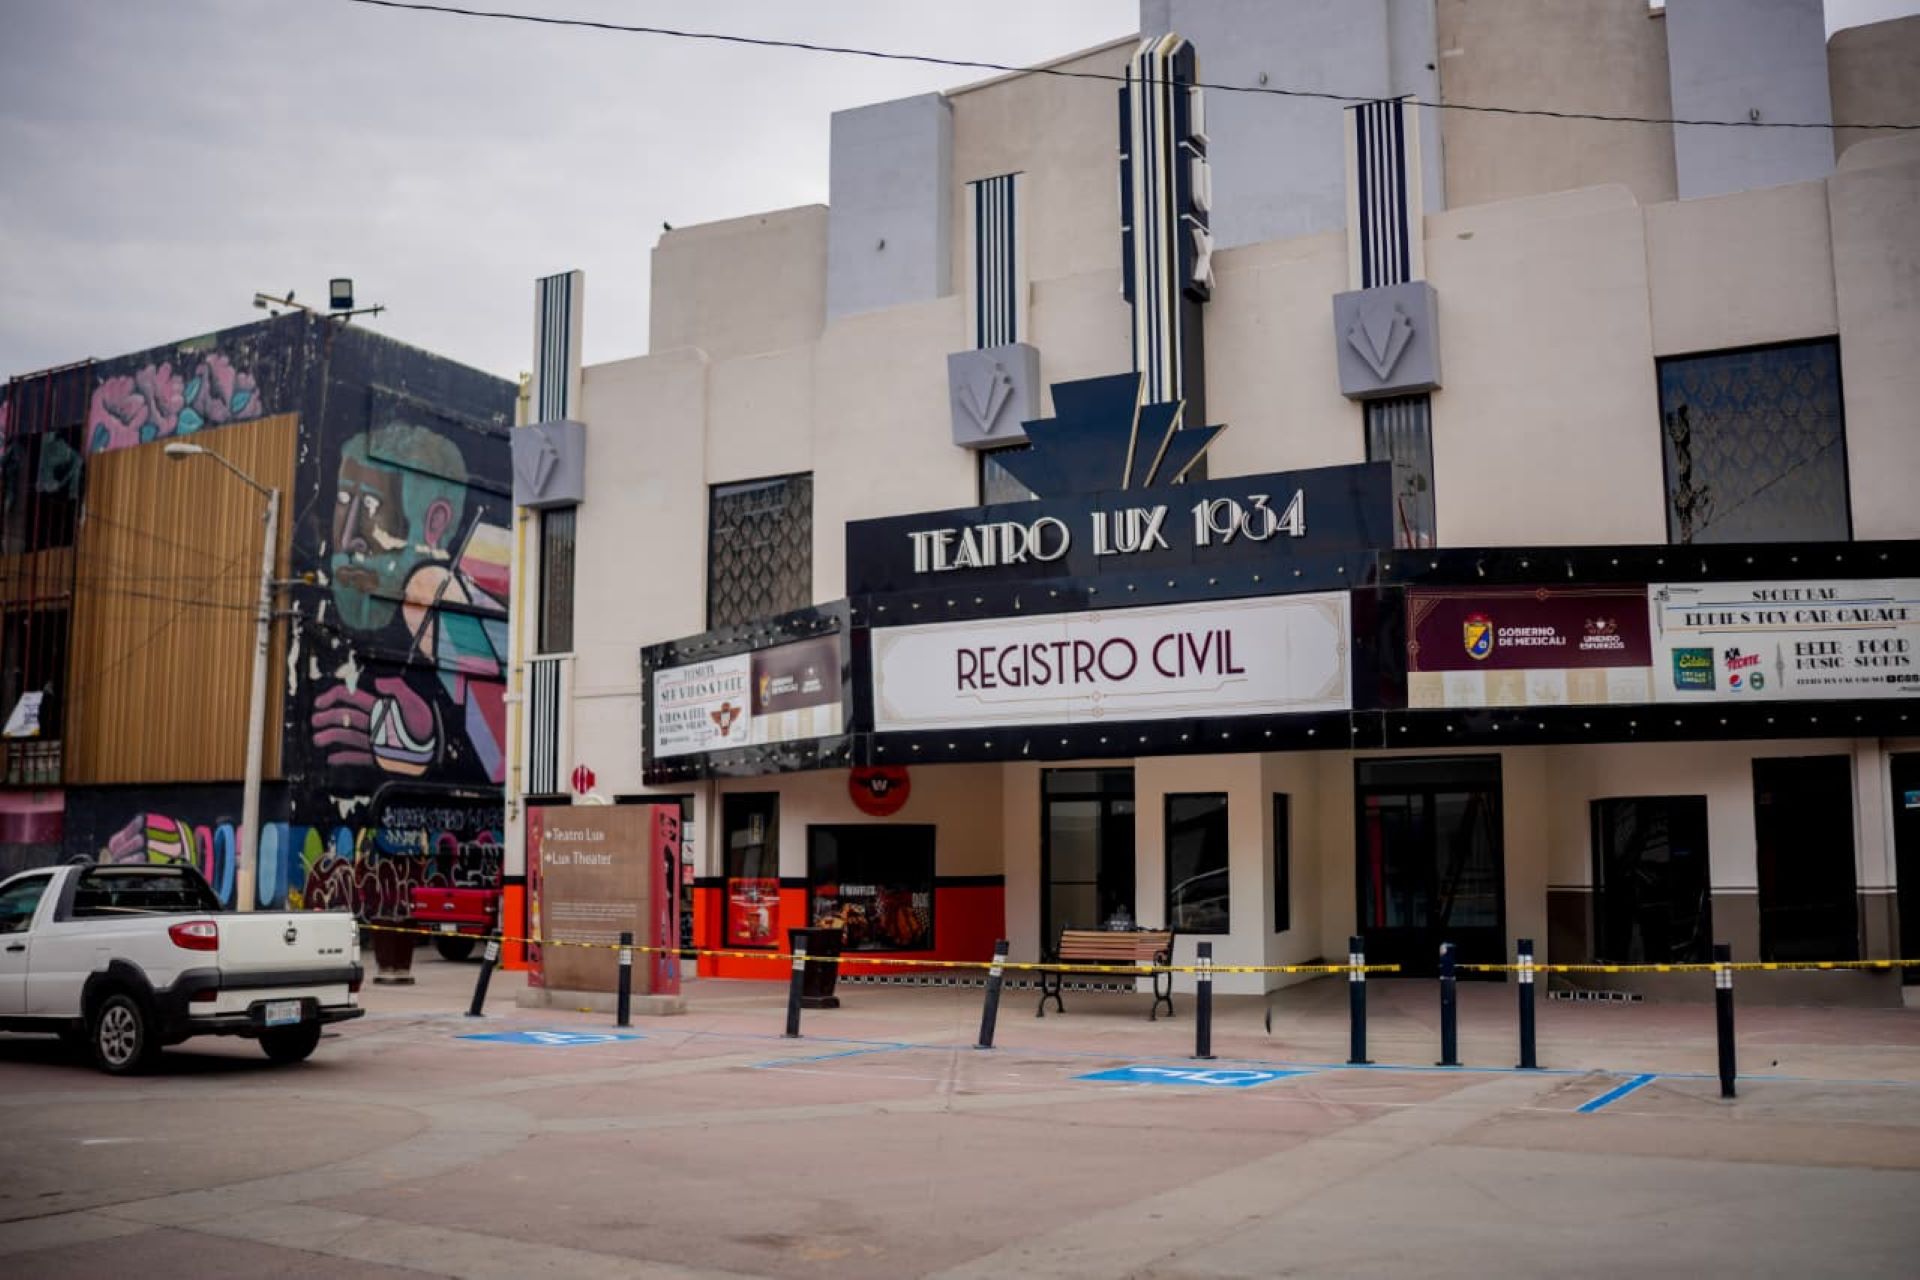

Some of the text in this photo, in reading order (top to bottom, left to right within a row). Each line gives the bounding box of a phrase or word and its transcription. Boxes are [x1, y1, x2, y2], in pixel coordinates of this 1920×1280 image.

[907, 489, 1307, 573] TEATRO LUX 1934
[1754, 611, 1790, 624] TOY
[1794, 609, 1833, 623] CAR
[1498, 627, 1555, 637] GOBIERNO
[1499, 636, 1567, 646] DE MEXICALI
[1795, 638, 1910, 655] BEER FOOD
[957, 629, 1246, 691] REGISTRO CIVIL
[551, 827, 606, 841] Teatro Lux
[552, 851, 612, 864] Lux Theater
